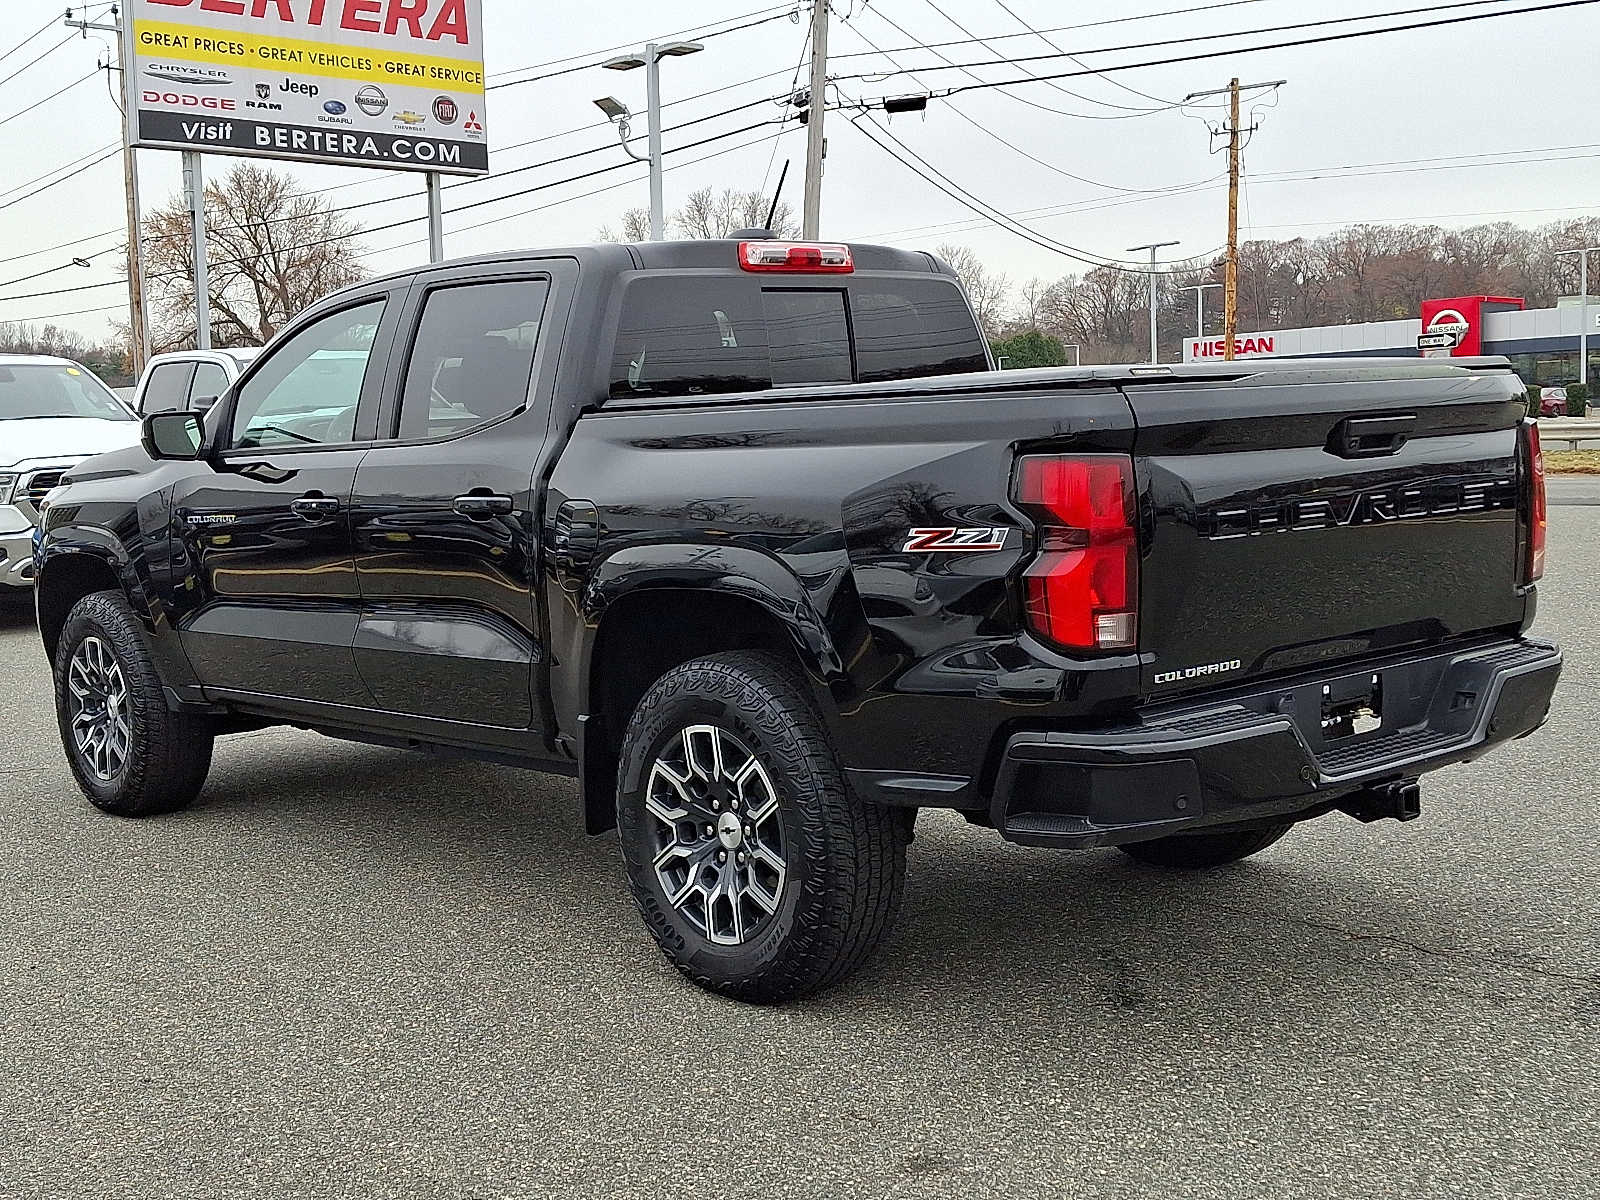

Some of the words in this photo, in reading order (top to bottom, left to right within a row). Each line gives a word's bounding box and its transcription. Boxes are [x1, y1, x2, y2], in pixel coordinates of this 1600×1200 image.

[140, 31, 189, 49] GREAT
[194, 37, 245, 55] PRICES
[258, 46, 303, 62] GREAT
[308, 51, 372, 71] VEHICLES
[385, 61, 426, 77] GREAT
[430, 66, 482, 84] SERVICE
[148, 63, 228, 78] CHRYSLER
[279, 78, 319, 98] Jeep
[142, 91, 236, 111] DODGE
[245, 101, 282, 111] RAM
[357, 96, 386, 106] NISSAN
[317, 115, 353, 125] SUBARU
[438, 104, 453, 119] FIAT
[181, 121, 233, 140] Visit
[255, 125, 461, 163] BERTERA.COM
[1430, 325, 1463, 334] NISSAN
[1193, 337, 1274, 357] NISSAN
[186, 514, 237, 524] COLORADO
[902, 527, 1010, 552] Z71
[1154, 659, 1241, 684] COLORADO
